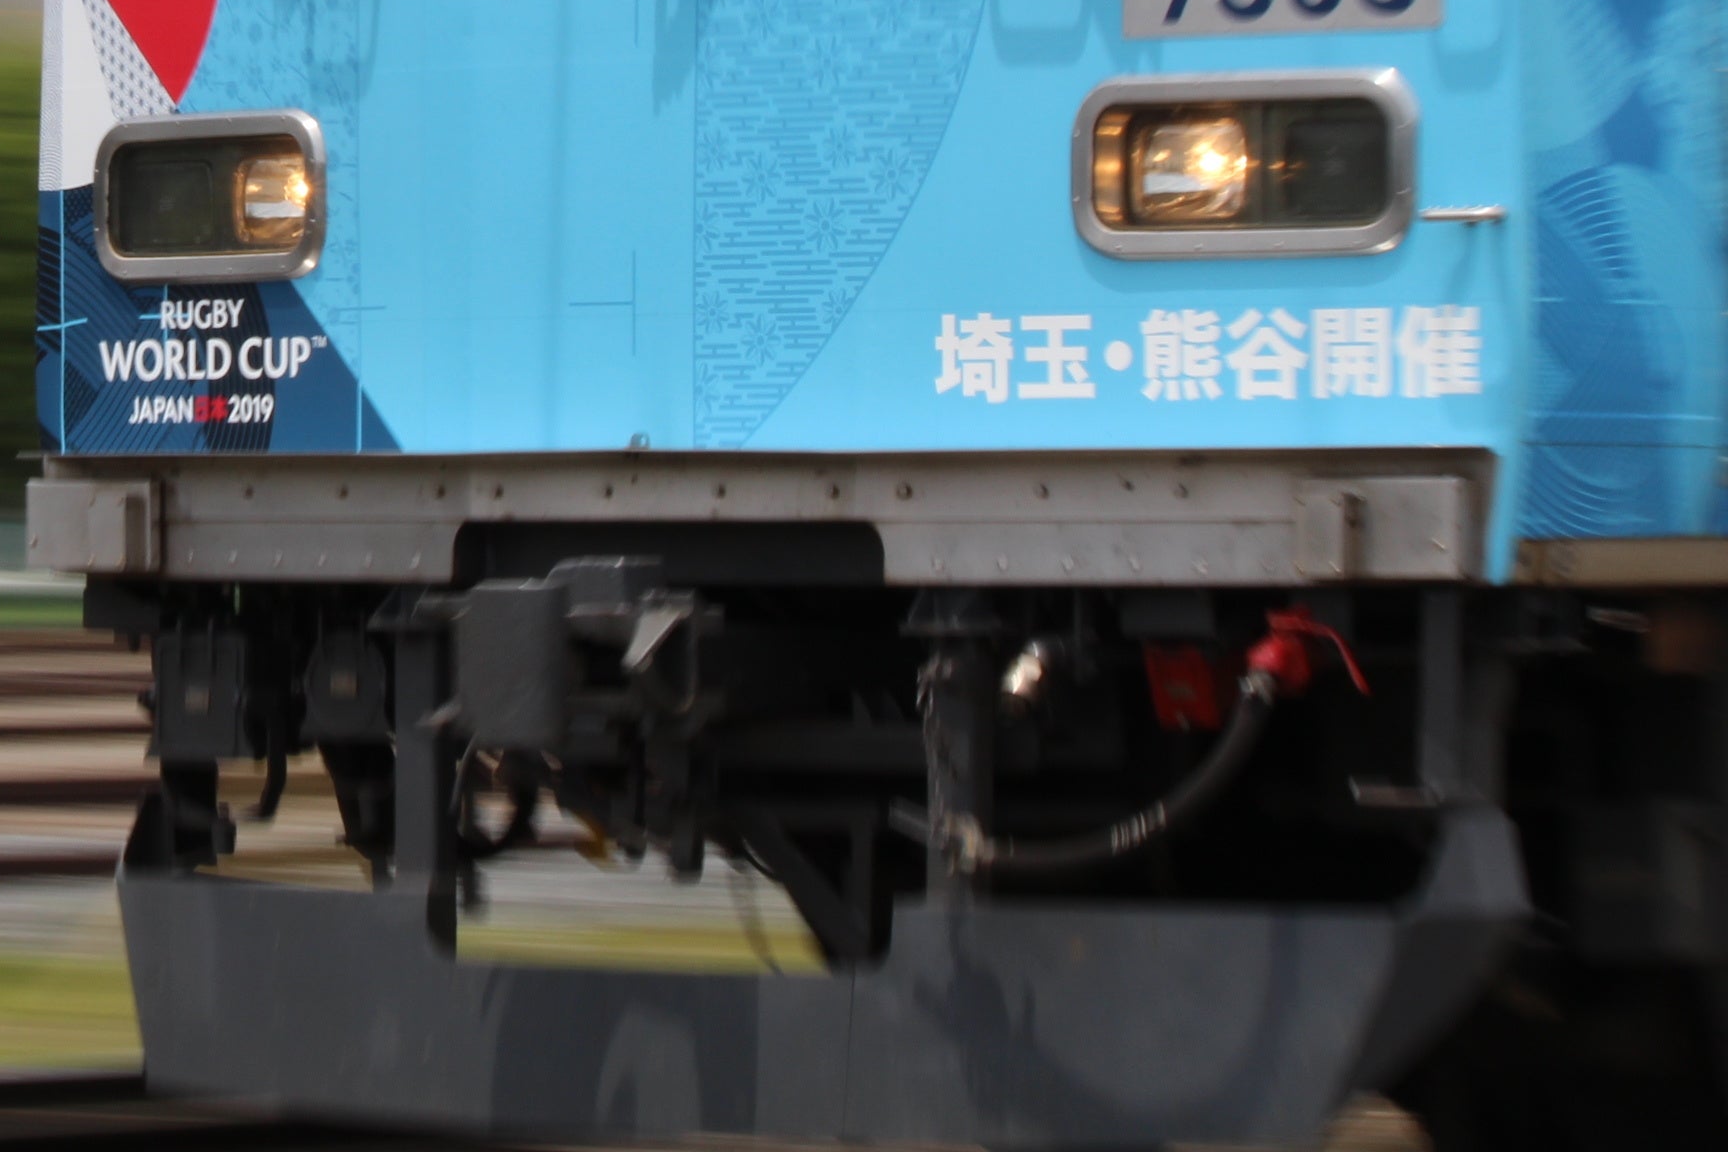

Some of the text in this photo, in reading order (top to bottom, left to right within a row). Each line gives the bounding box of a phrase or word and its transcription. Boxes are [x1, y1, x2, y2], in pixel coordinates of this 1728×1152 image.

[159, 298, 245, 330] RUGBY
[98, 338, 232, 383] WORLD
[237, 335, 312, 379] CUP
[128, 395, 194, 425] JAPAN
[227, 393, 275, 424] 2019
